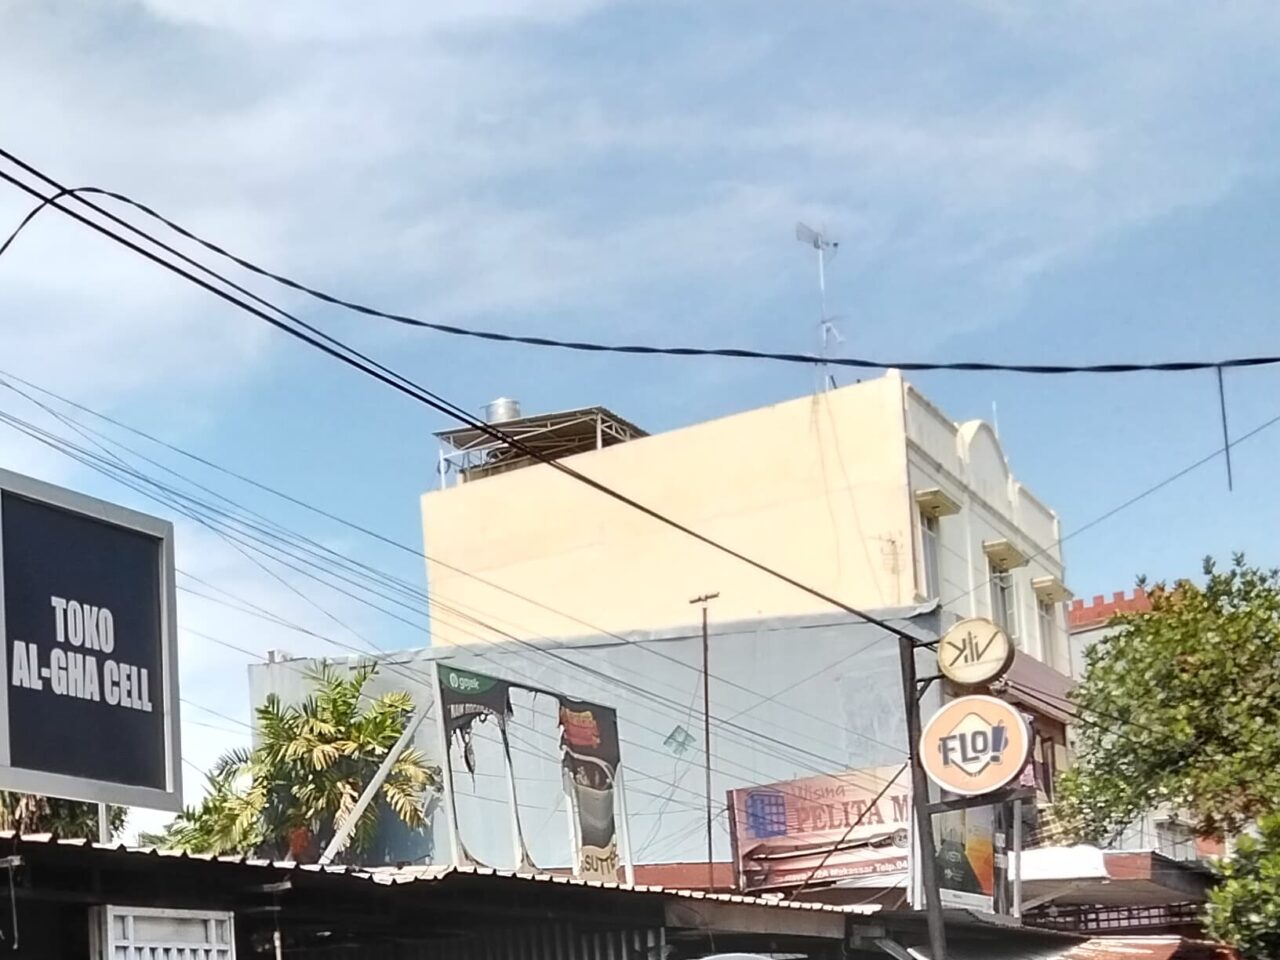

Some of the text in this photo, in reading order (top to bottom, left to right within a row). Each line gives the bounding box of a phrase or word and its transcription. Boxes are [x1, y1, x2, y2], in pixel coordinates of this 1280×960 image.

[51, 596, 115, 653] TOKO
[12, 640, 152, 712] AL-GHA CELL
[938, 721, 1007, 767] FLO!
[795, 798, 884, 833] PELITA
